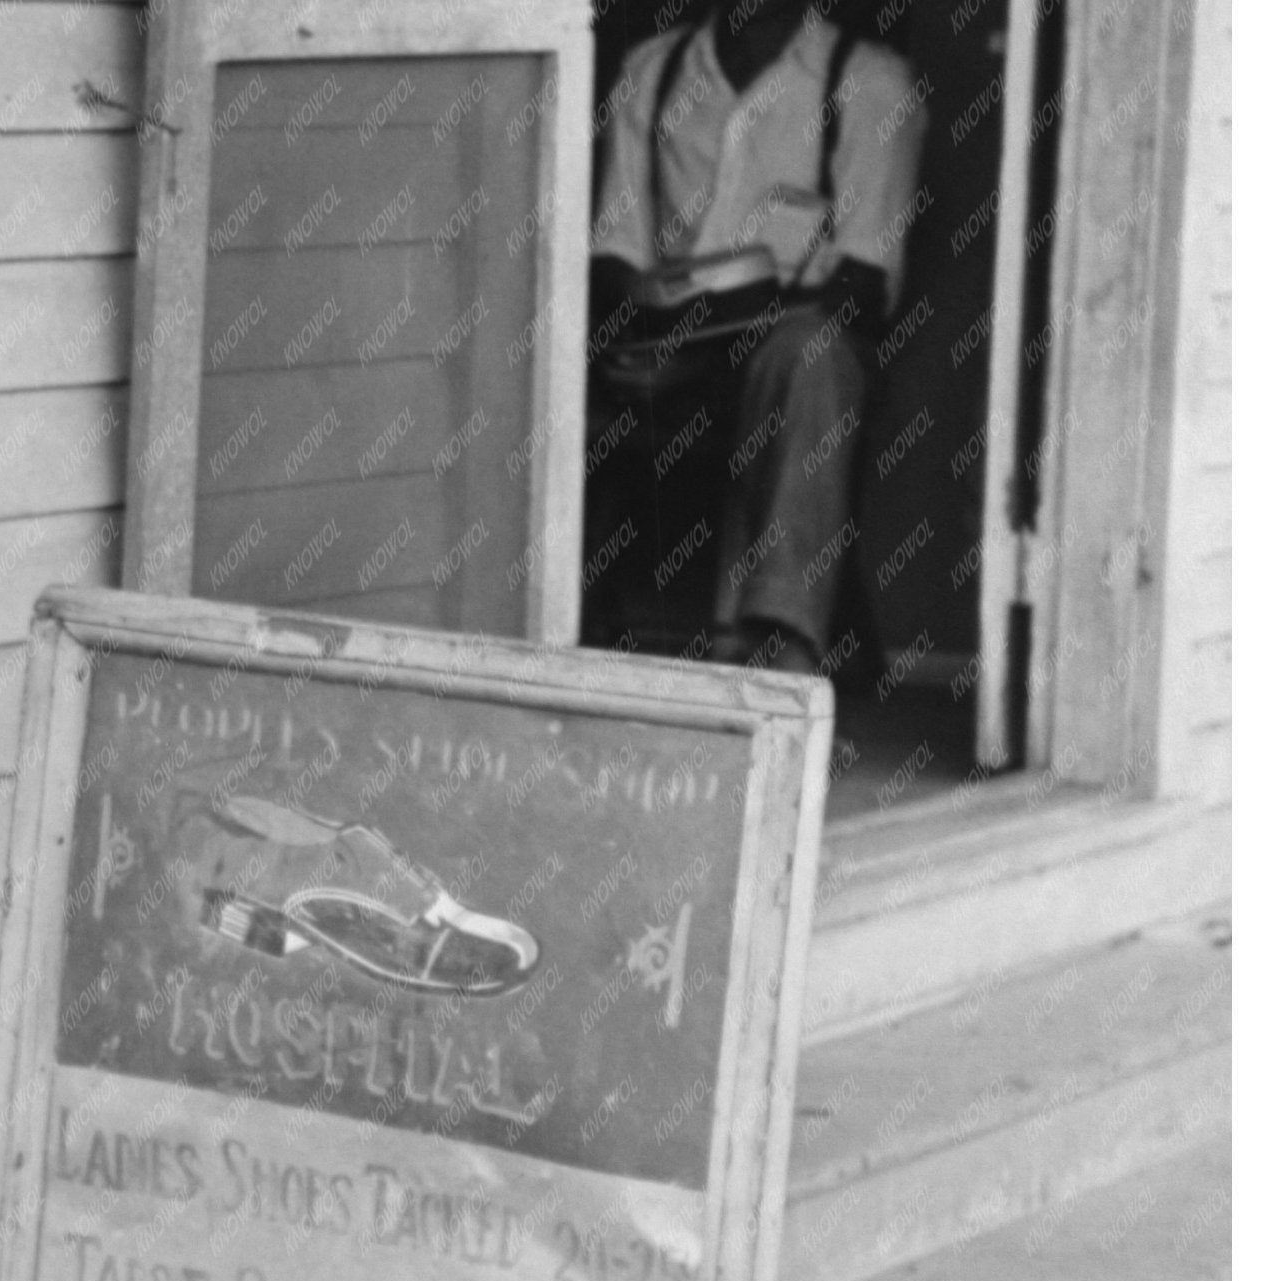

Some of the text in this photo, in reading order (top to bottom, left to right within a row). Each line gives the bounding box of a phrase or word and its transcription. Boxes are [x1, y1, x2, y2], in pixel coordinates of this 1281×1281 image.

[167, 970, 555, 1126] HOSPITAL
[54, 1104, 205, 1203] LADIES
[220, 1137, 355, 1237] SHOES
